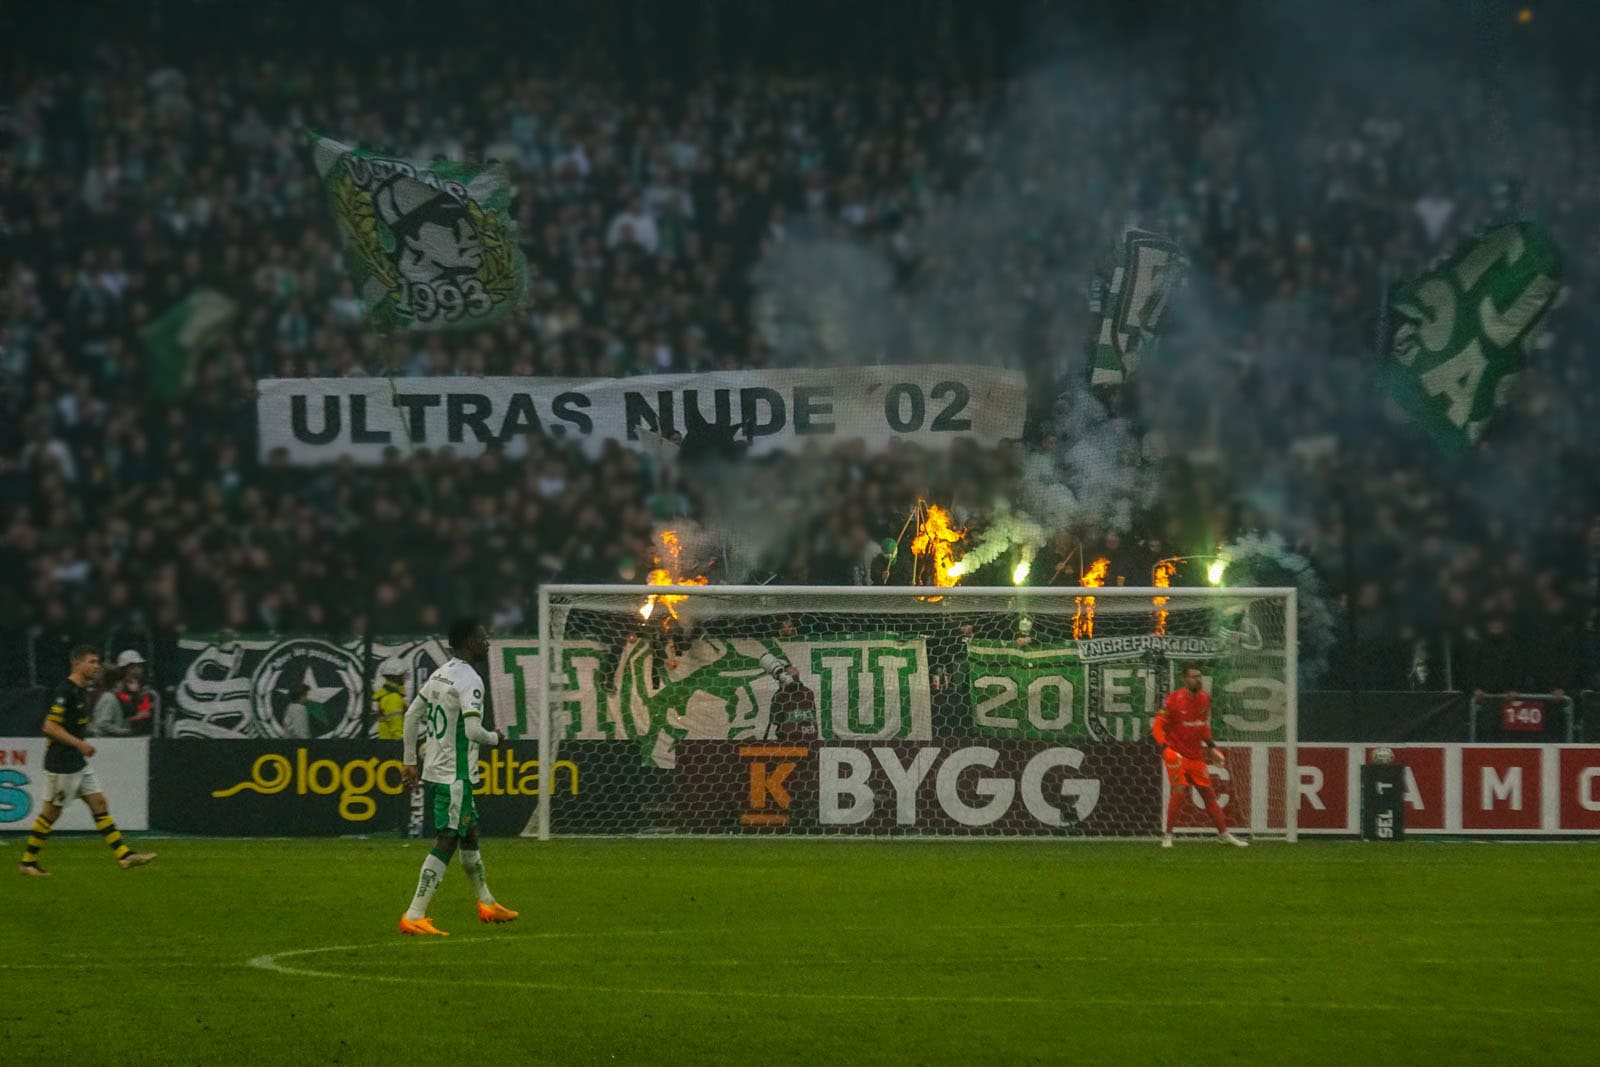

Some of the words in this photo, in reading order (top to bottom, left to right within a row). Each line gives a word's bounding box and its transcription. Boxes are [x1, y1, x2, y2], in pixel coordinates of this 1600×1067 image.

[395, 276, 492, 322] 1993
[291, 391, 593, 446] ULTRAS
[974, 675, 1073, 730] 20
[1506, 708, 1542, 724] 140
[818, 746, 1101, 827] BYGG
